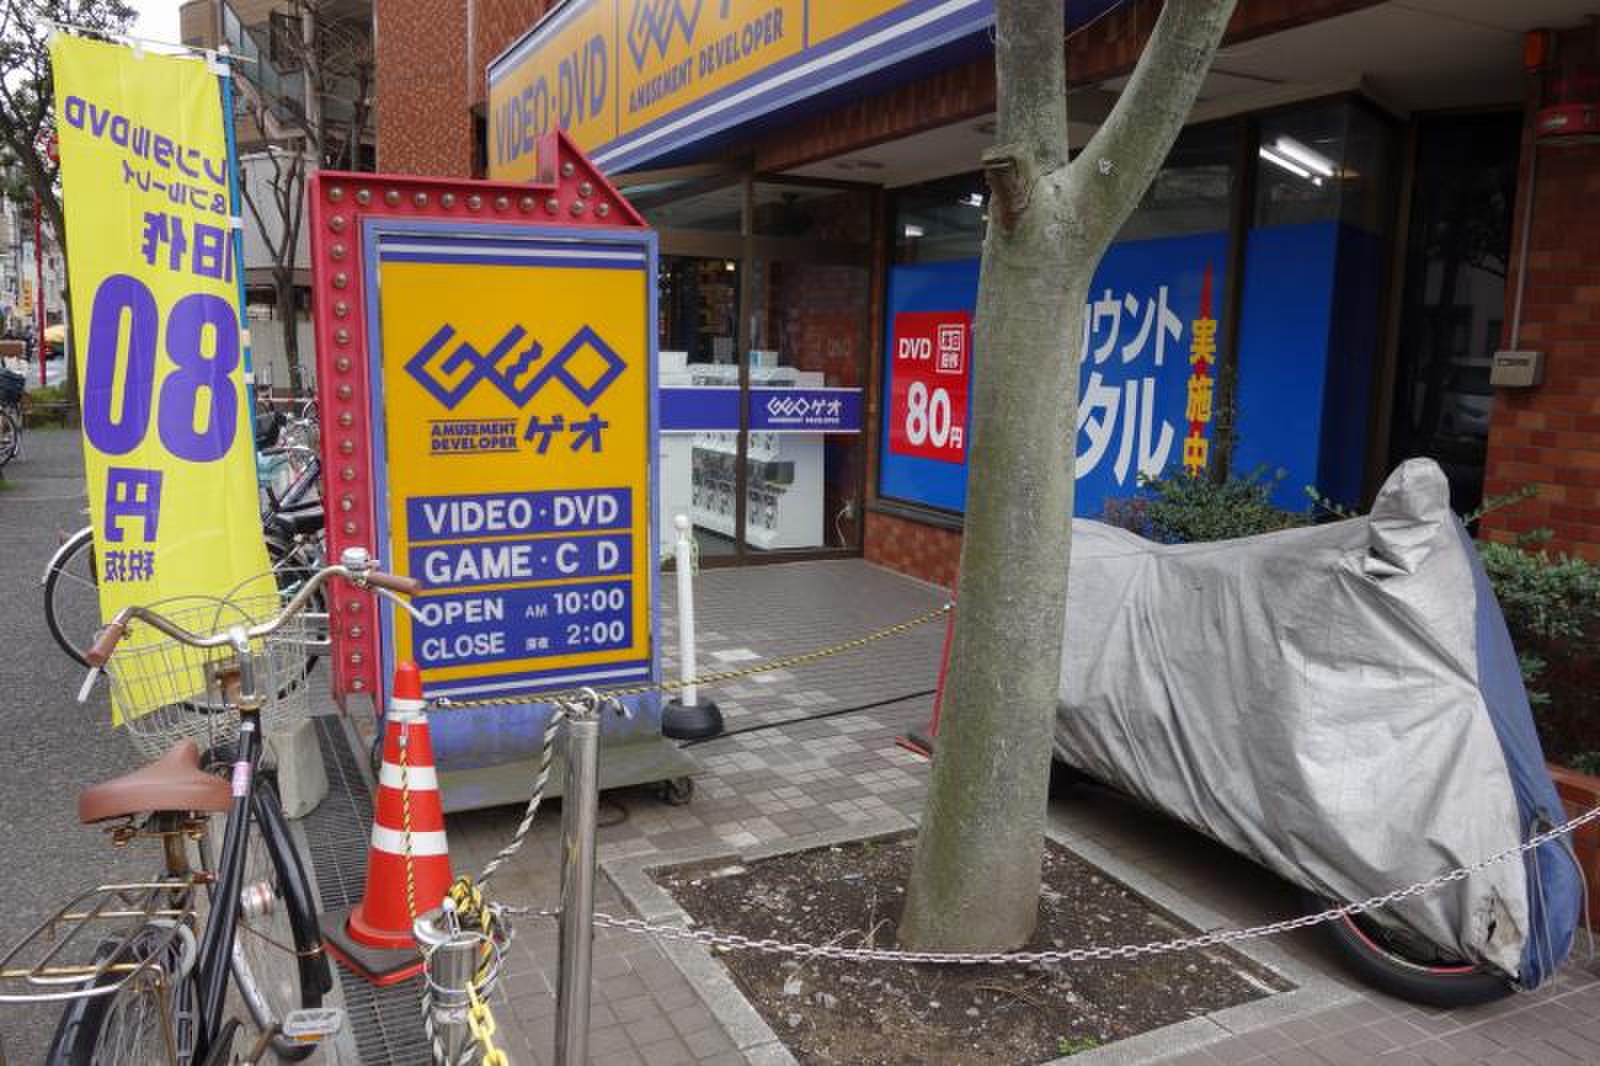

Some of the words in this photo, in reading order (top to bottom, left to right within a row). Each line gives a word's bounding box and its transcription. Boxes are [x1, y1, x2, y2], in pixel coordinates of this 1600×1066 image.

[629, 58, 693, 112] AMUSEMENT
[699, 8, 784, 78] DEVELOPER
[1080, 286, 1184, 366] ウント
[898, 337, 932, 360] DVD
[1183, 316, 1217, 479] 実施中
[431, 422, 517, 437] AMUSEMENT
[431, 436, 518, 451] DEVELOPER
[524, 412, 609, 455] ゲオ
[1075, 371, 1175, 487] タル
[421, 598, 504, 627] OPEN
[525, 604, 547, 619] AM
[553, 588, 625, 615] 10:00
[421, 632, 505, 661] CLOSE
[566, 621, 625, 646] 2:00
